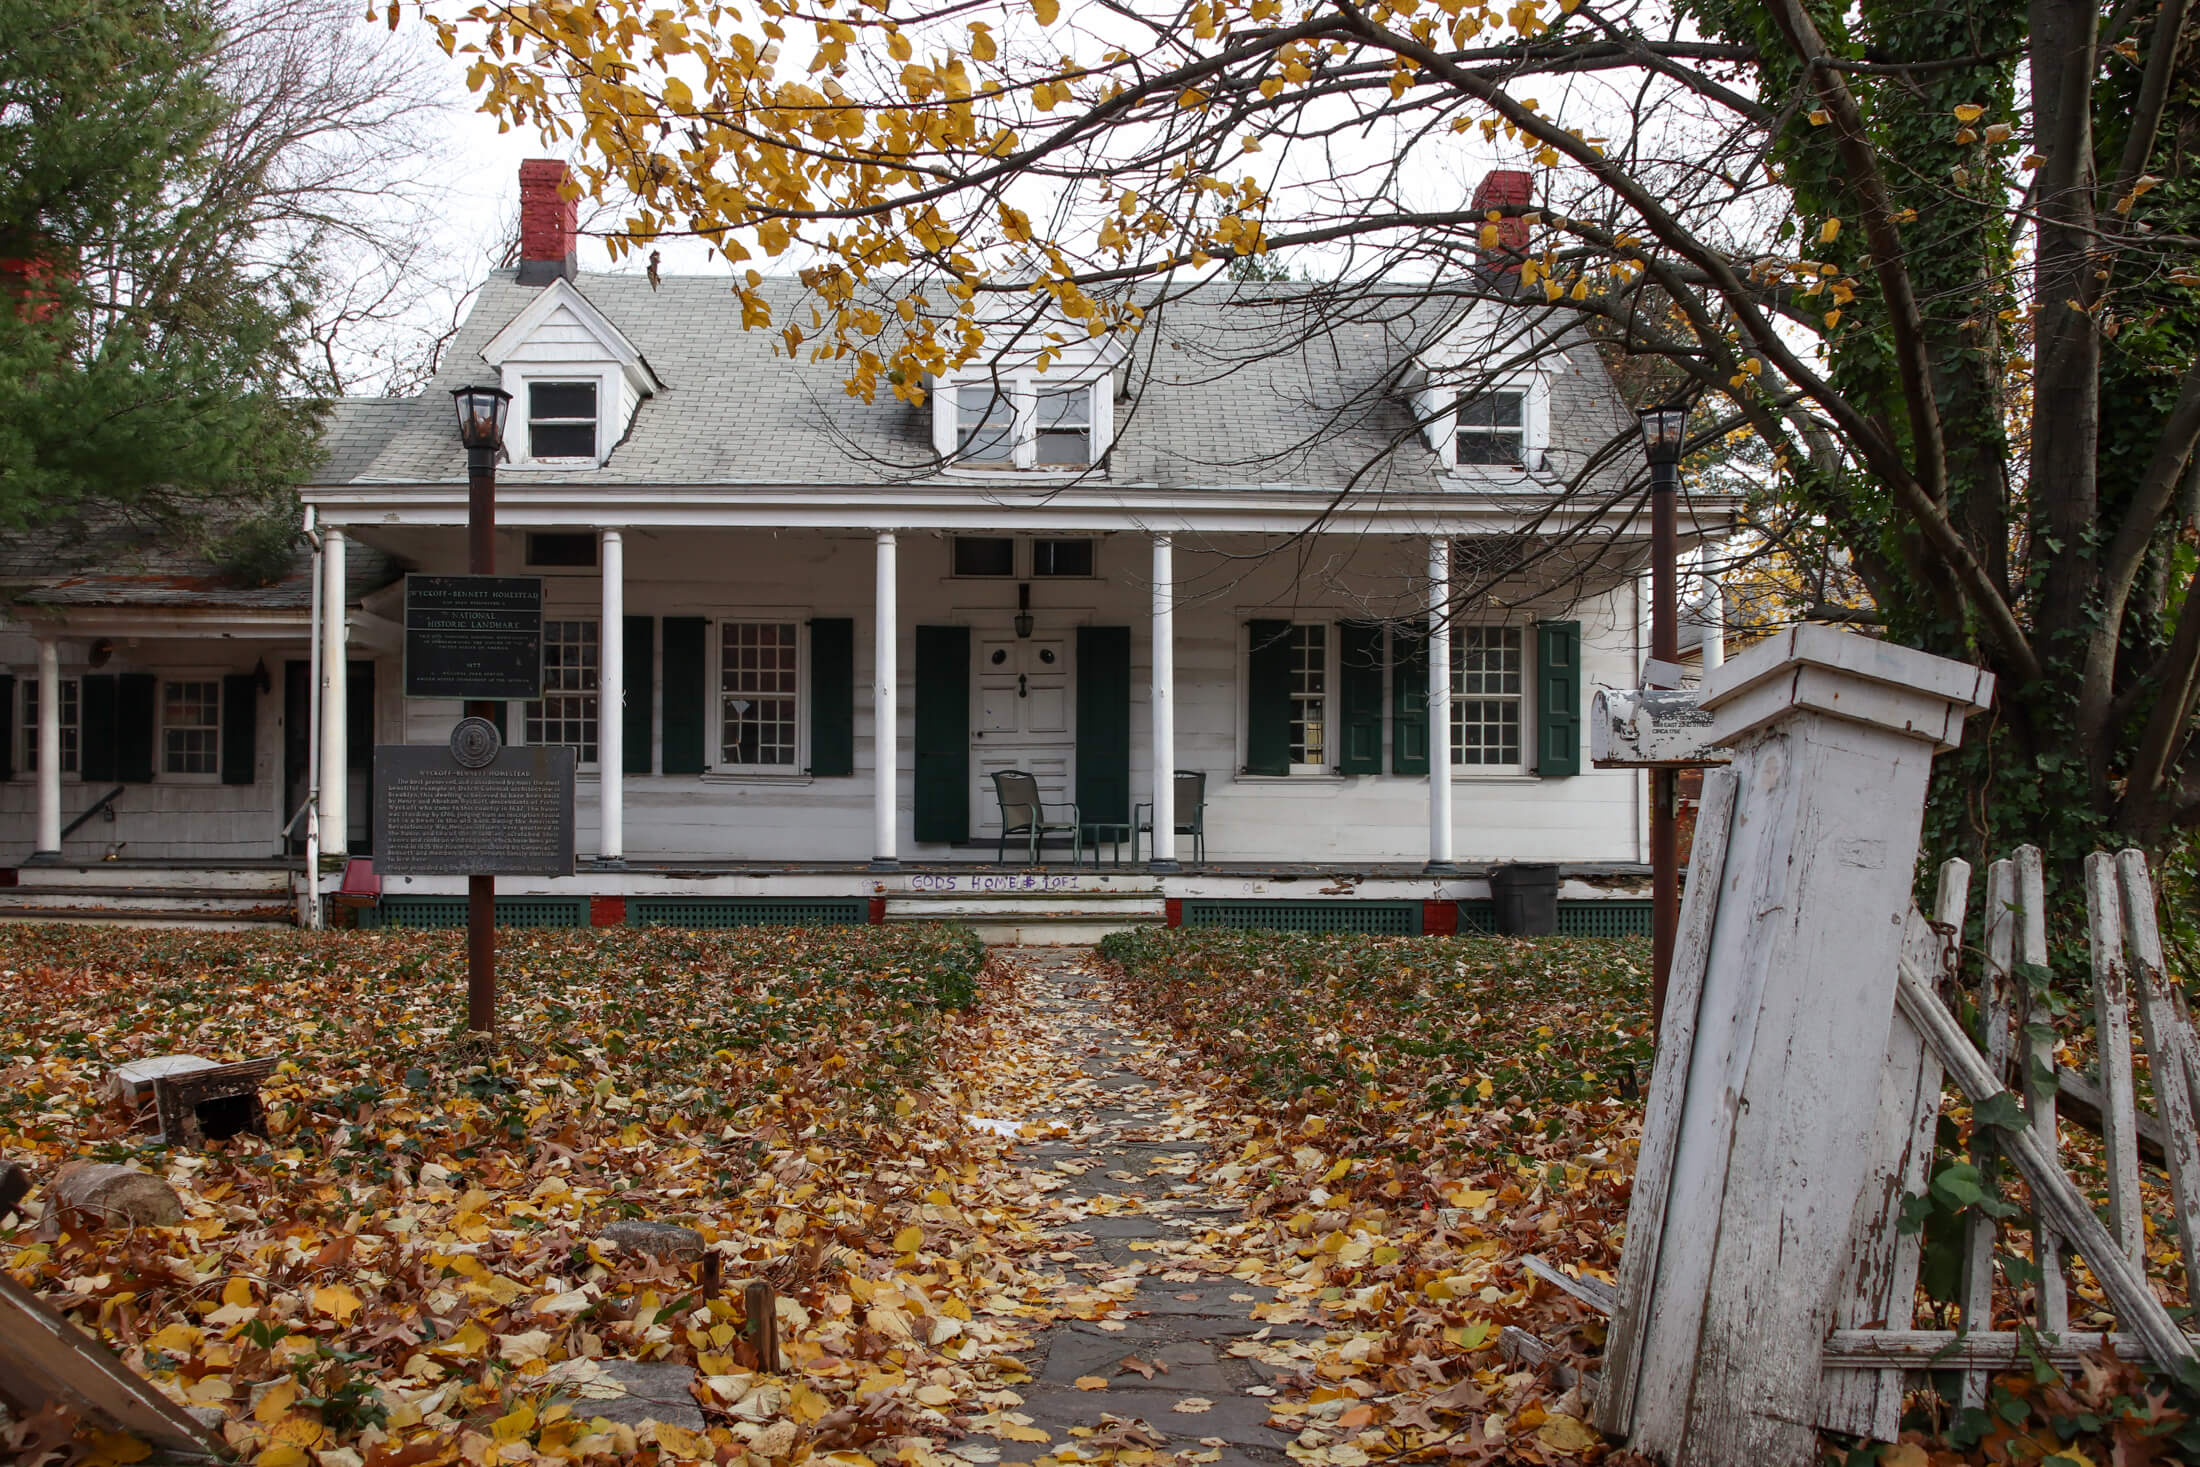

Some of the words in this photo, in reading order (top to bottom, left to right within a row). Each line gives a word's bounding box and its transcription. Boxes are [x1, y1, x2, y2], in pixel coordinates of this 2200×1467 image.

[452, 611, 496, 620] NATIONAL
[427, 620, 467, 628] HISTORIC
[912, 875, 957, 890] GODS
[972, 875, 1017, 890] HOME
